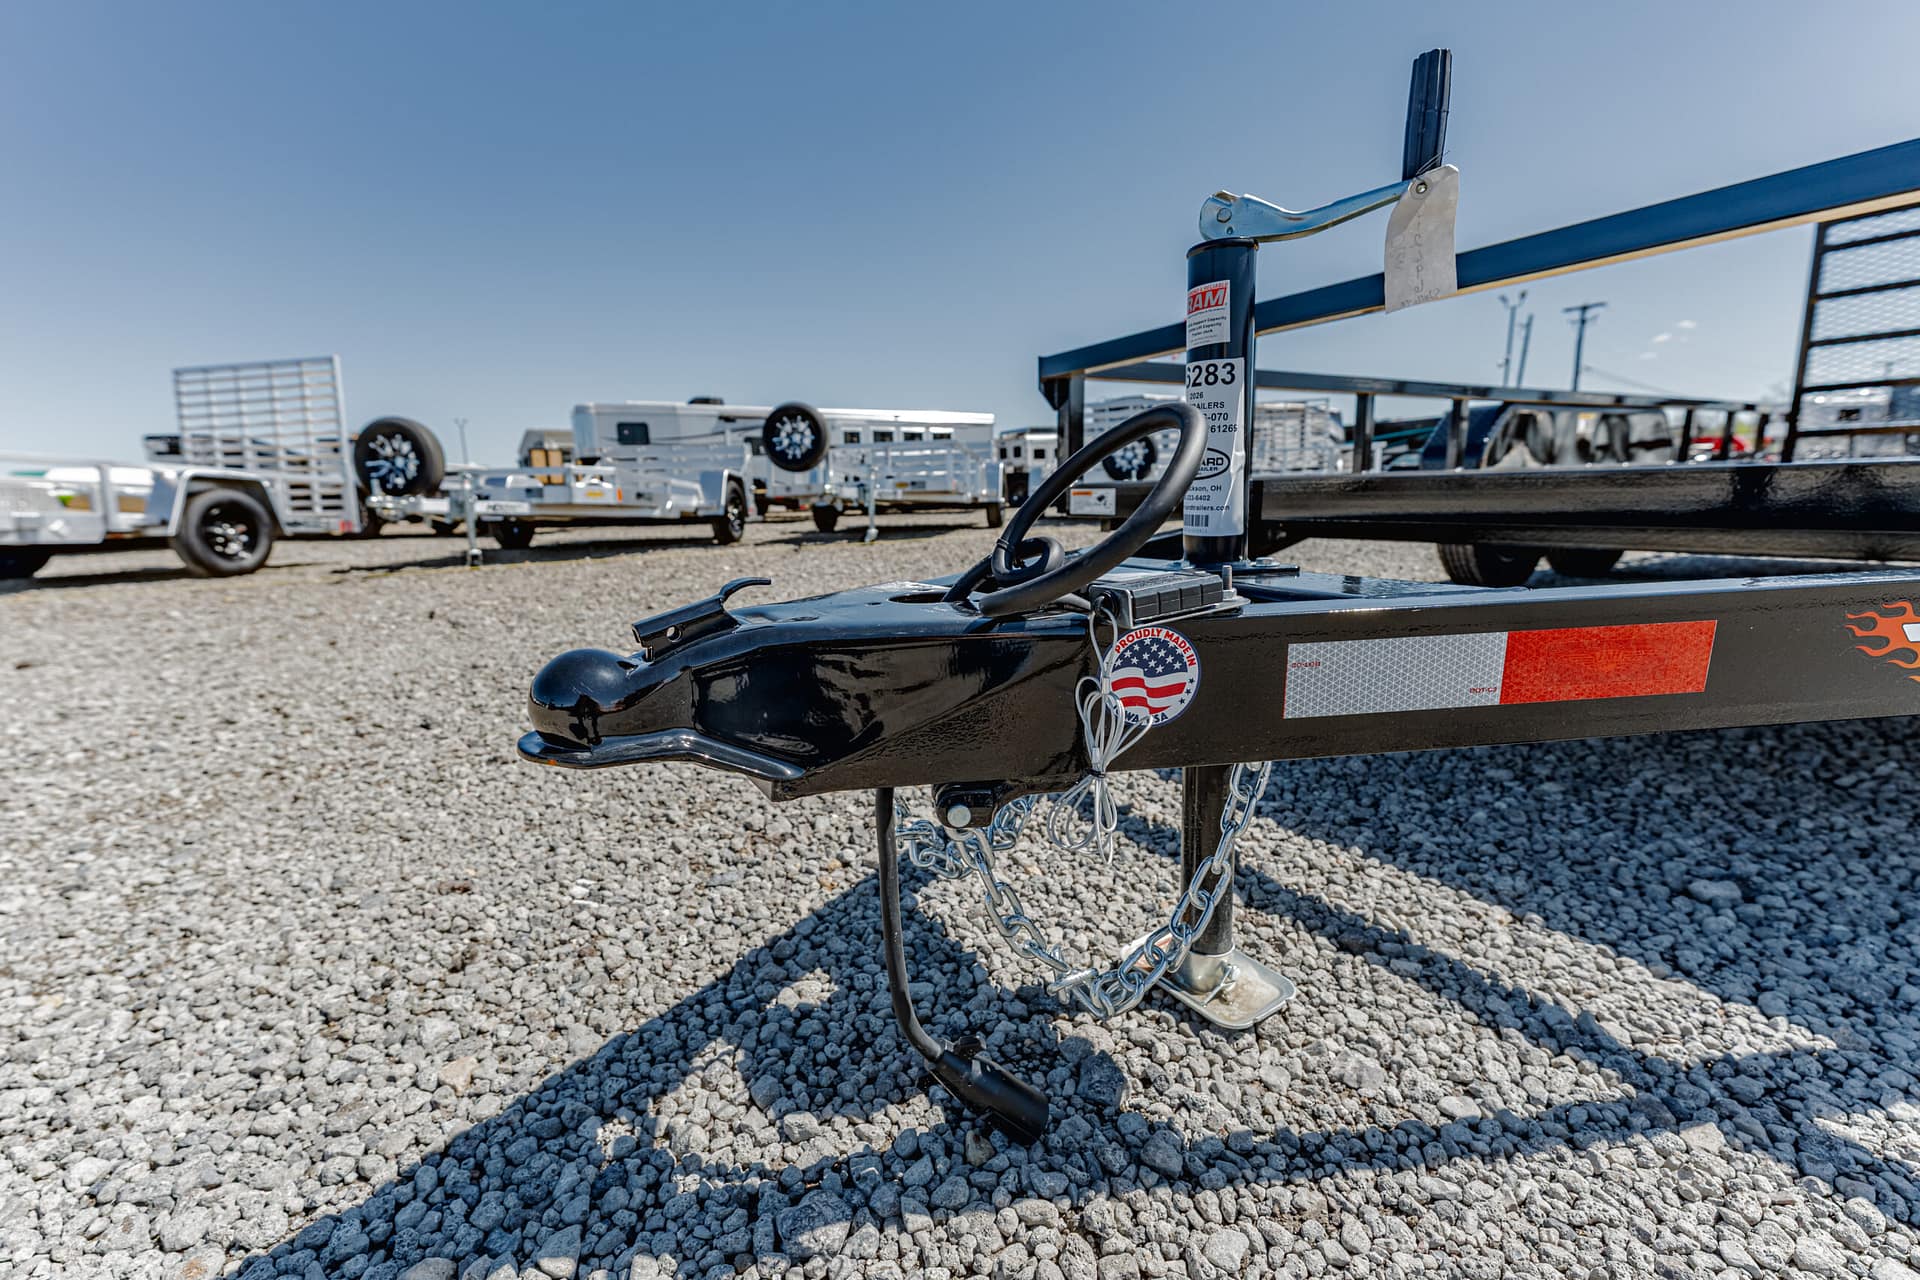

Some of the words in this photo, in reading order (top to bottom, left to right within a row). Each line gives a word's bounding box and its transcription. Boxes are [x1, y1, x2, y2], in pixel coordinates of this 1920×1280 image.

[1191, 401, 1225, 410] AILERS
[1114, 628, 1163, 654] PROUDLY
[1164, 630, 1192, 655] MADE
[1186, 653, 1197, 667] IN
